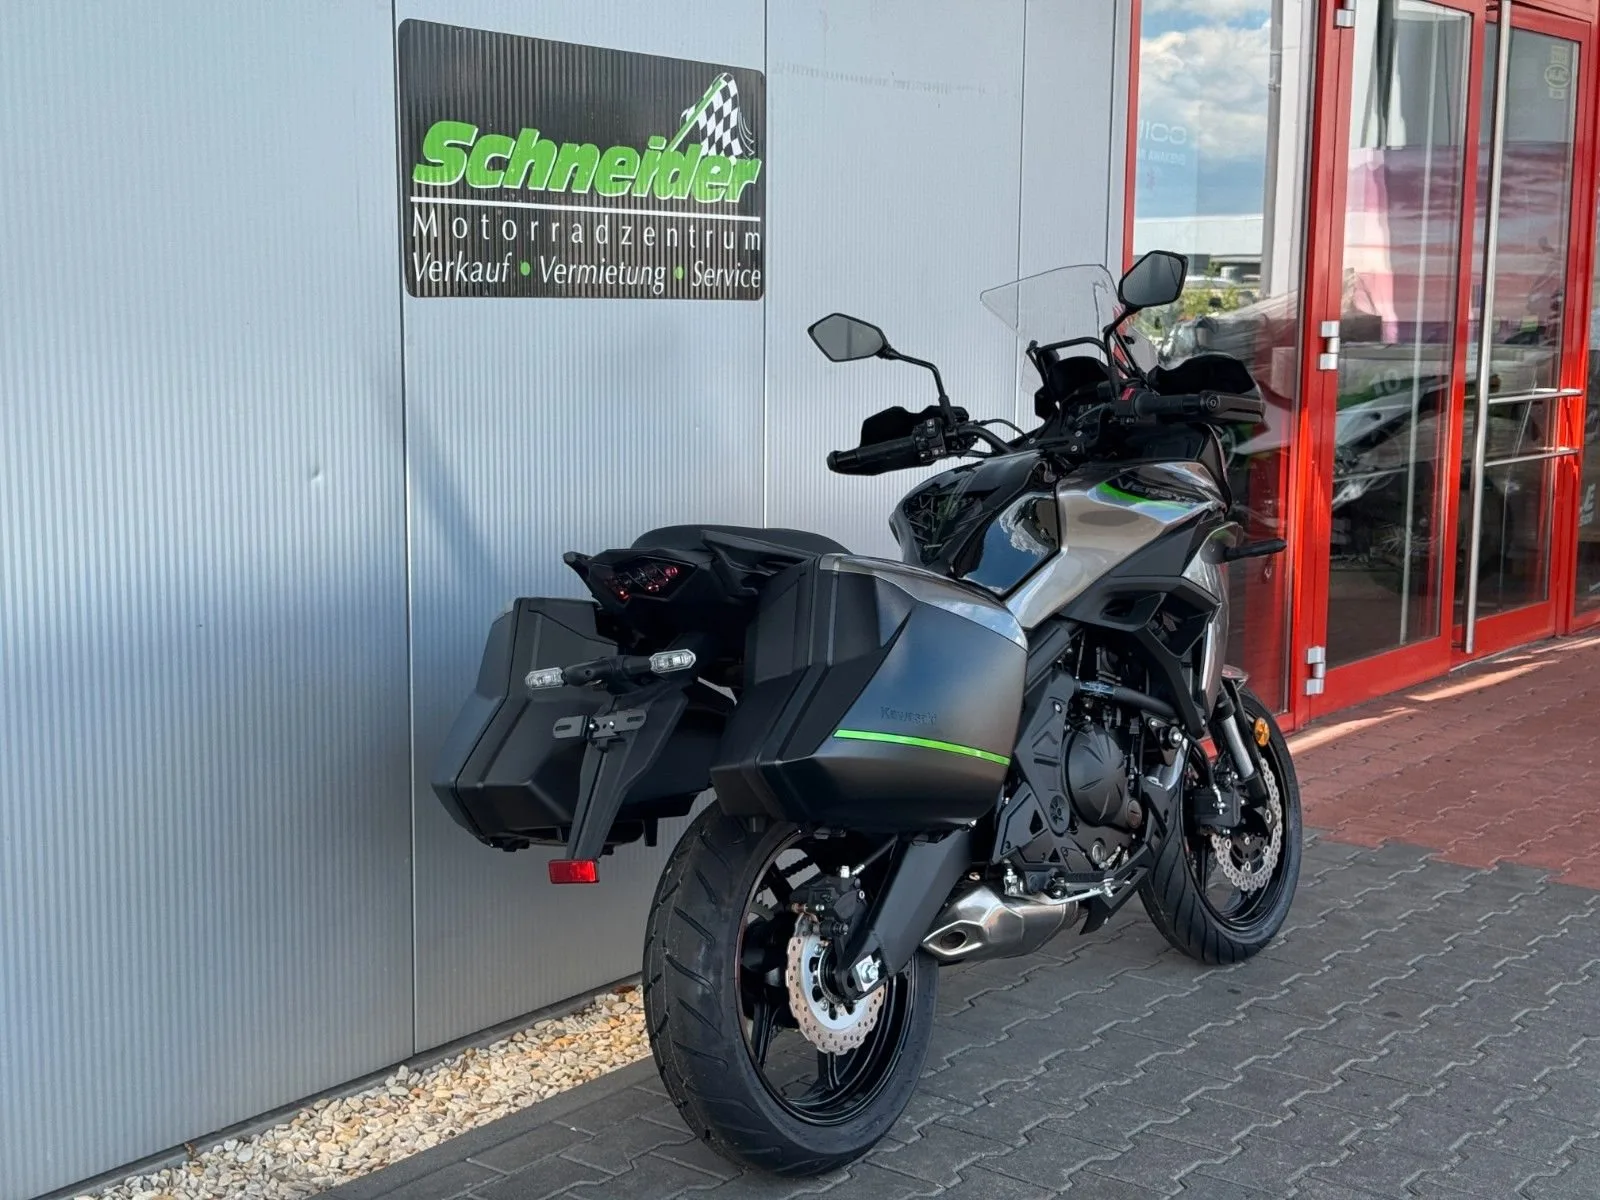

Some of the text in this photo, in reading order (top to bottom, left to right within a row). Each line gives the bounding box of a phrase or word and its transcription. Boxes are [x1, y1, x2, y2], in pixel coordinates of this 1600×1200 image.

[412, 120, 762, 203] Schneider
[412, 206, 761, 251] Motorradzentrum
[413, 251, 761, 294] Verkauf Vermietung Service
